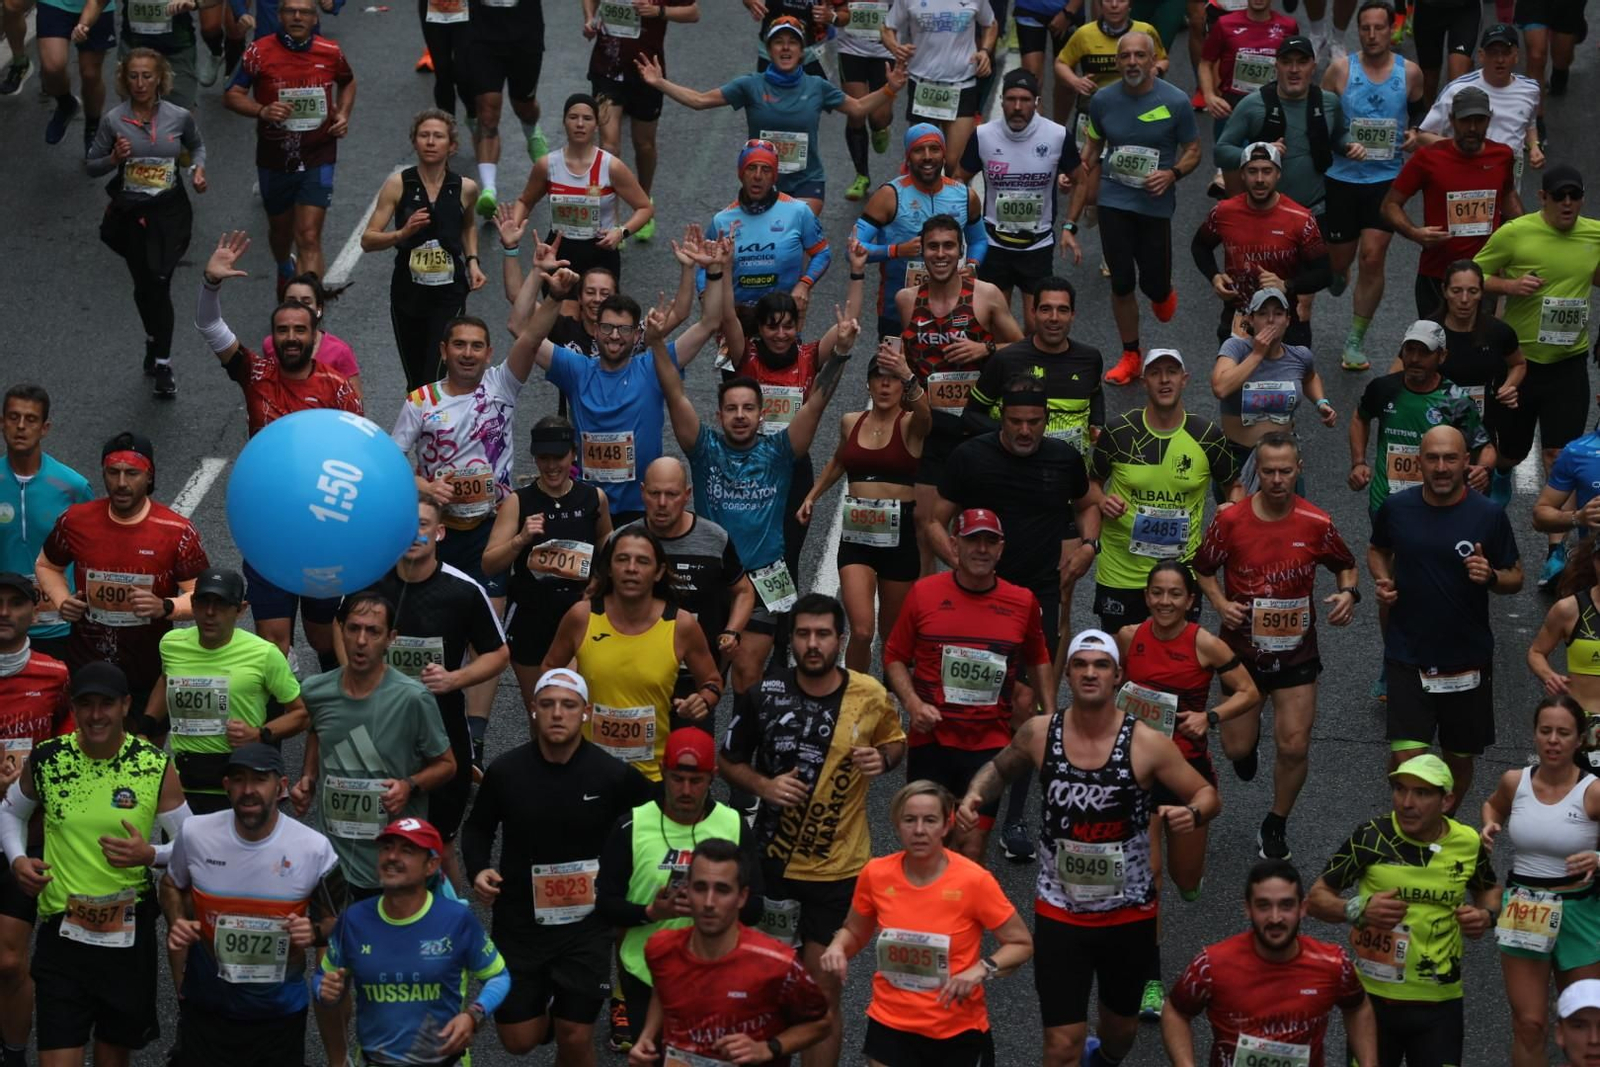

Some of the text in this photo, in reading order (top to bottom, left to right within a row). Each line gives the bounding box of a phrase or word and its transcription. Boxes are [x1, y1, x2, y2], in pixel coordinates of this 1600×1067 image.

[133, 5, 162, 17] 9135
[604, 5, 632, 19] 9692
[852, 11, 879, 24] 8819
[1240, 63, 1270, 77] 7537
[922, 88, 949, 102] 8760
[1356, 128, 1386, 142] 6679
[1116, 155, 1147, 171] 9557
[1002, 201, 1033, 216] 9030
[1455, 201, 1487, 217] 6171
[738, 243, 775, 253] KIA
[1550, 309, 1580, 325] 7058
[917, 330, 969, 345] KENYA
[937, 384, 971, 400] 4332
[764, 398, 790, 414] 250
[421, 428, 459, 464] 35
[588, 445, 622, 462] 4148
[1394, 457, 1421, 473] 601
[309, 458, 364, 522] 1:50
[453, 480, 481, 496] 830
[723, 479, 759, 490] MEDIA
[1130, 488, 1190, 504] ALBALAT
[851, 508, 886, 525] 9534
[1142, 519, 1178, 537] 2485
[538, 551, 576, 570] 5701
[1262, 612, 1298, 628] 5916
[386, 651, 433, 667] 10283
[950, 661, 990, 682] 6954
[174, 691, 211, 710] 8261
[1125, 695, 1161, 721] 7705
[601, 720, 641, 738] 5230
[331, 792, 372, 813] 6770
[1048, 779, 1122, 812] CORRE
[798, 802, 829, 858] MEDIO
[1065, 855, 1108, 876] 6949
[545, 877, 588, 898] 5623
[1395, 886, 1456, 903] ALBALAT
[77, 905, 119, 925] 5557
[225, 933, 273, 955] 9872
[1355, 929, 1392, 954] 3945
[888, 944, 932, 966] 8035
[362, 983, 442, 1002] TUSSAM
